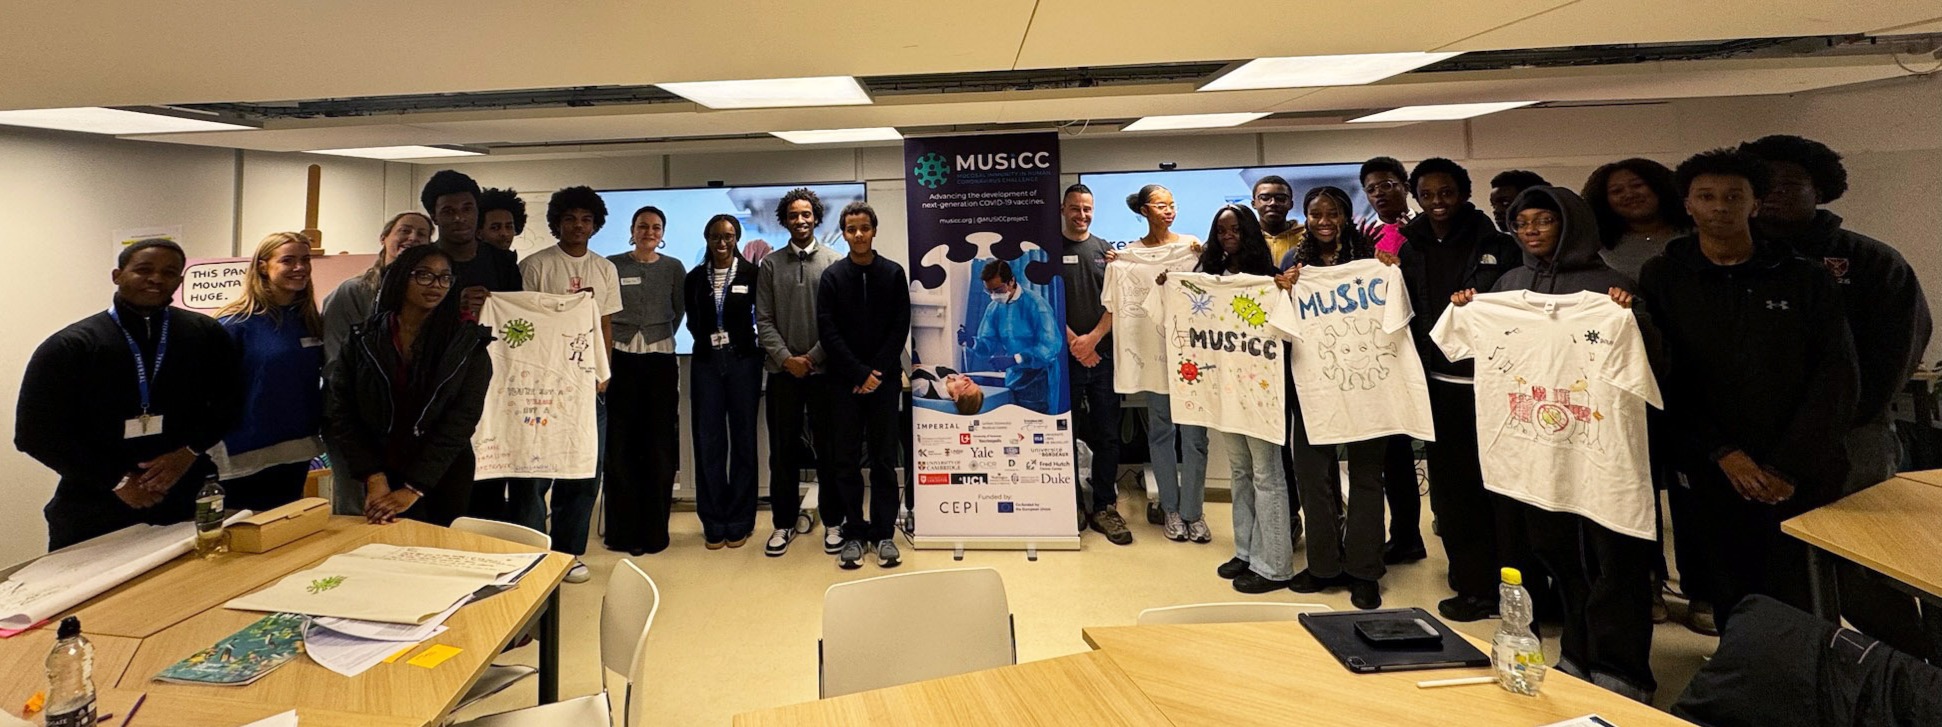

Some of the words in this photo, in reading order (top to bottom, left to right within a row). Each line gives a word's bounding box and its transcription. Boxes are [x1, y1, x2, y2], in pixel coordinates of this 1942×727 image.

[929, 193, 967, 201] Advancing
[968, 191, 980, 199] the
[981, 190, 1028, 200] development
[1029, 189, 1037, 197] of
[922, 200, 978, 209] next-generation
[979, 199, 1013, 207] COVID-19
[939, 217, 973, 225] musicc.org
[223, 268, 248, 277] PAN
[192, 279, 242, 290] MOUNTA
[190, 292, 228, 302] HUGE.
[134, 353, 146, 384] IMPERIAL
[543, 406, 550, 414] A
[524, 416, 548, 426] HERO
[970, 446, 994, 458] Yale
[962, 476, 986, 485] UCL
[1041, 472, 1071, 484] Duke
[939, 501, 978, 514] CEPI
